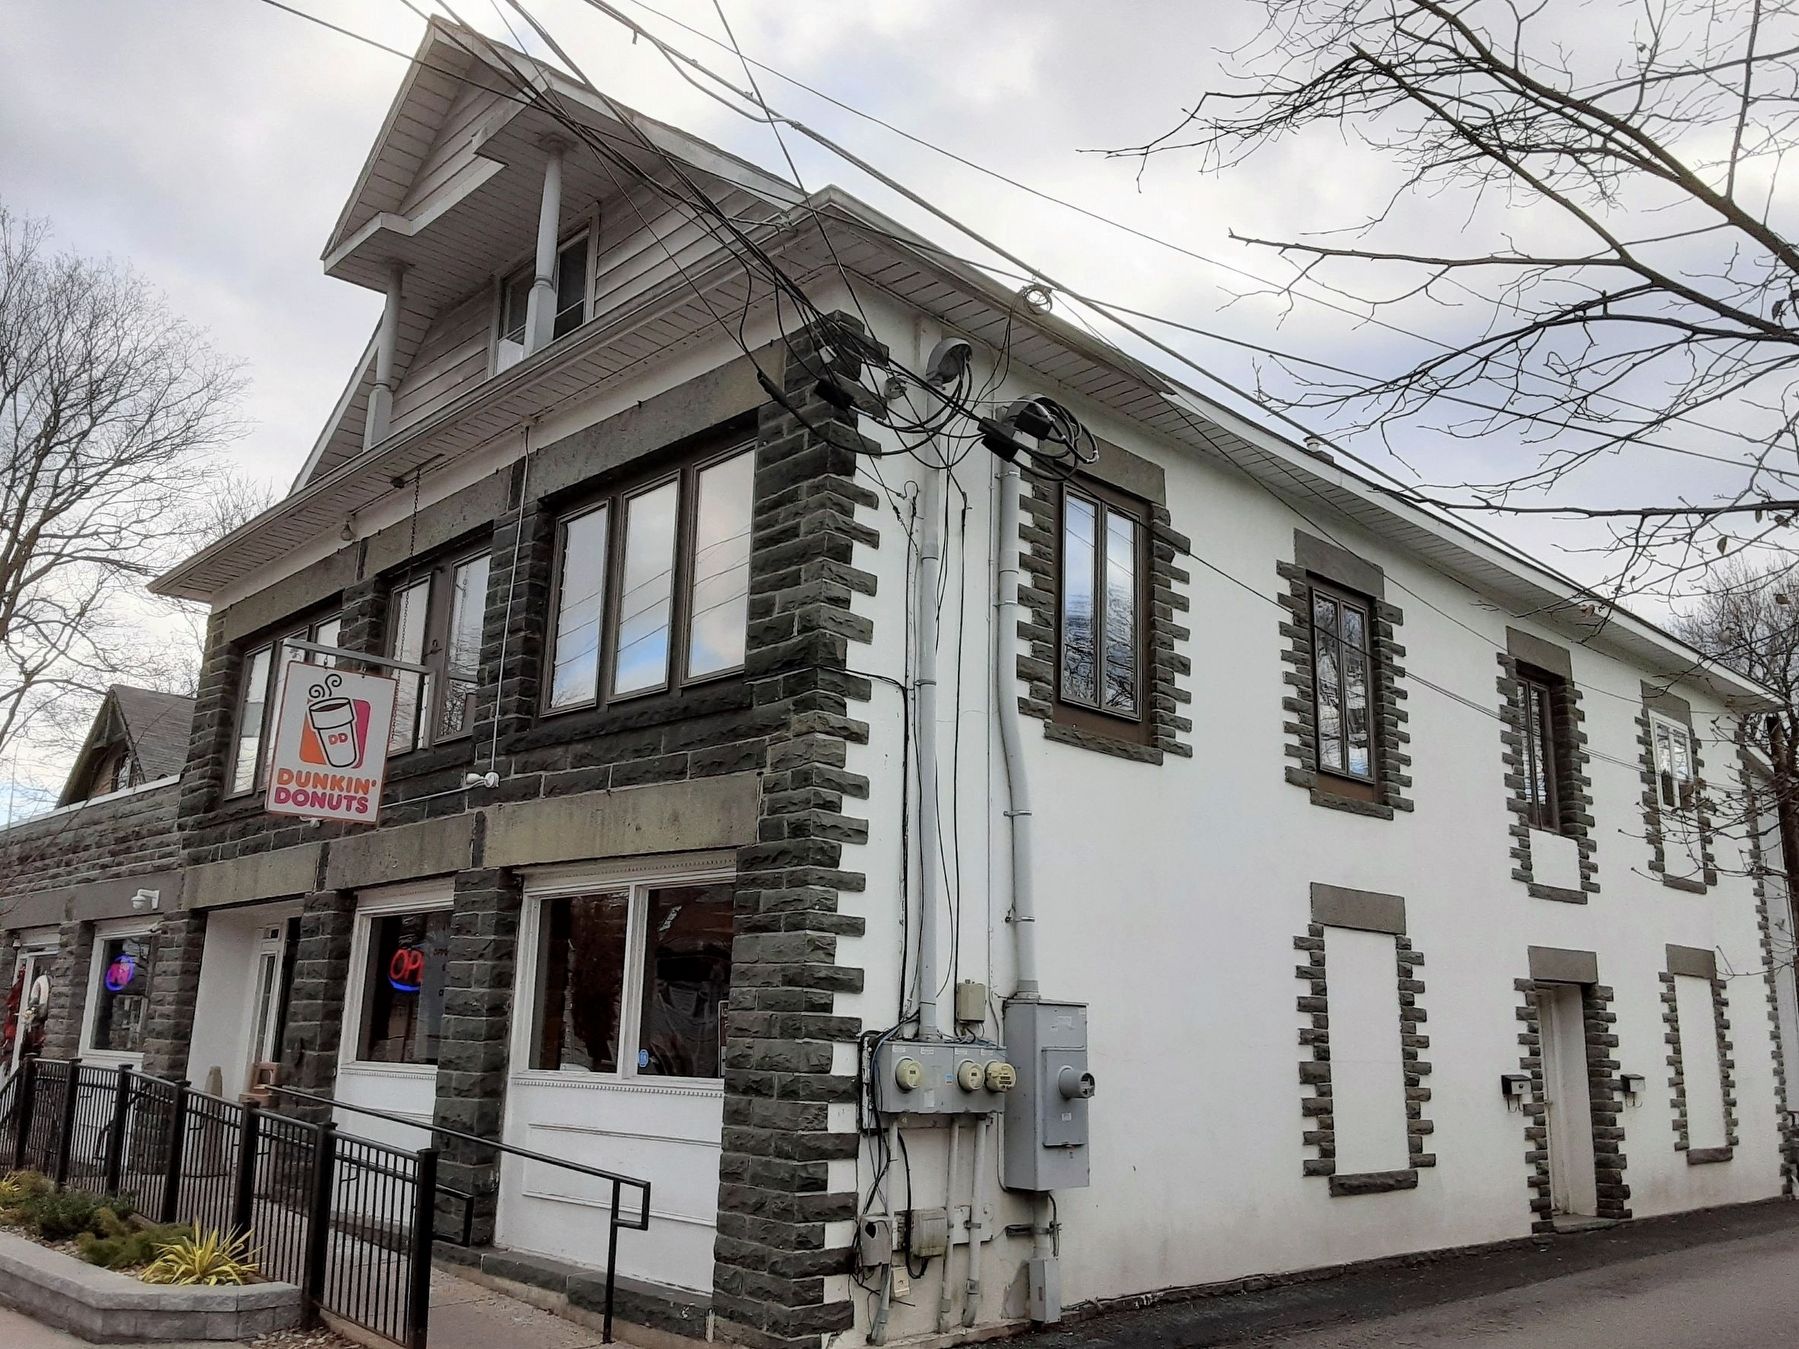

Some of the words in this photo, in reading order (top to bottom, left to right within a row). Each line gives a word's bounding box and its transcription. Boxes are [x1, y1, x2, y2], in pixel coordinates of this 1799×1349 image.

[327, 732, 349, 746] DD
[277, 767, 377, 795] DUNKIN'
[274, 786, 369, 814] DONUTS
